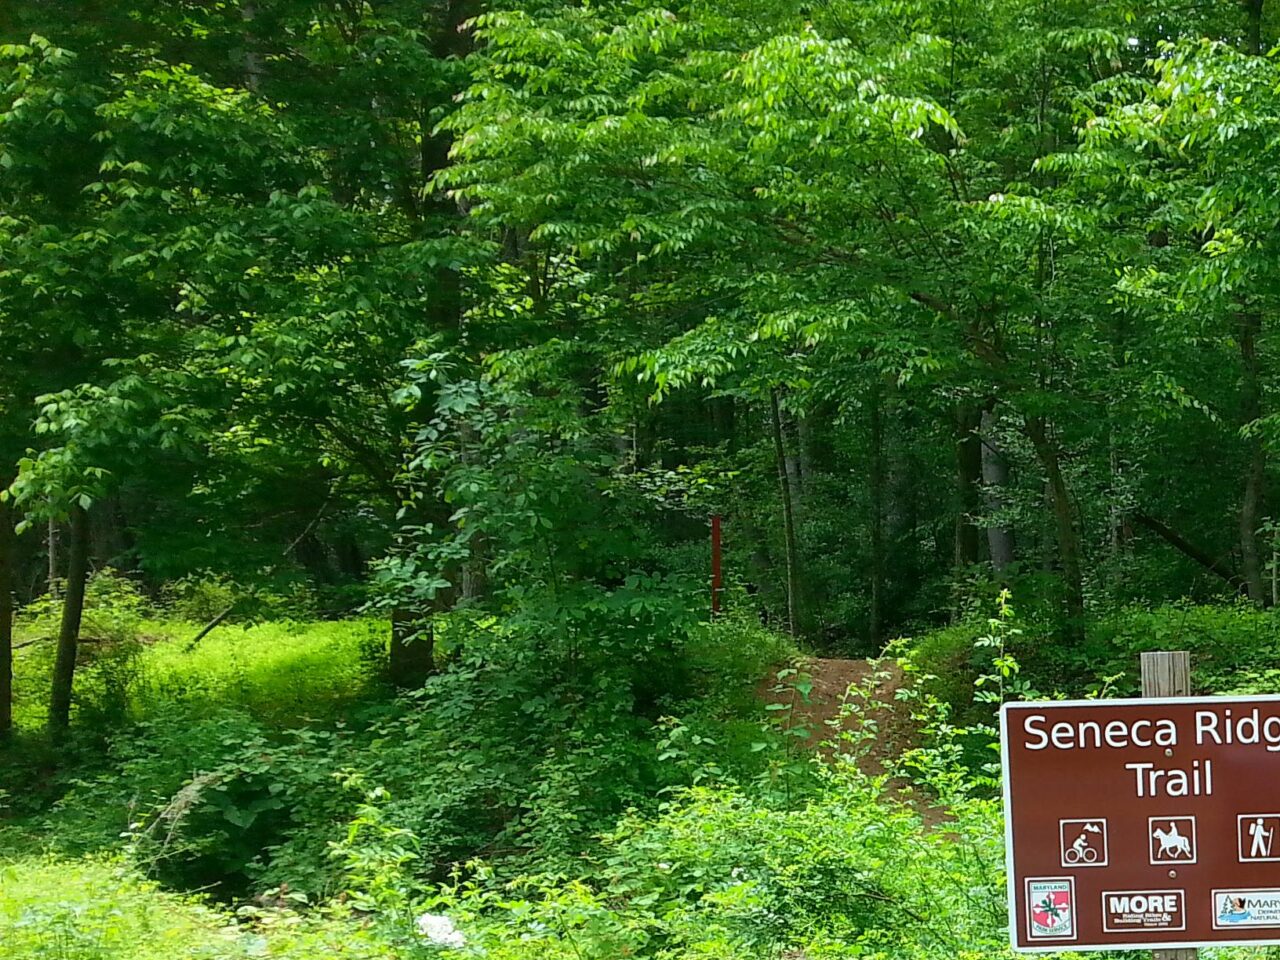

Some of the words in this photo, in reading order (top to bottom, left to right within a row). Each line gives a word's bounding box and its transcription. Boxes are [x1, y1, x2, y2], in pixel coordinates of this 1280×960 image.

[1023, 713, 1178, 750] Seneca
[1125, 759, 1213, 797] Trail
[1109, 895, 1178, 914] MORE
